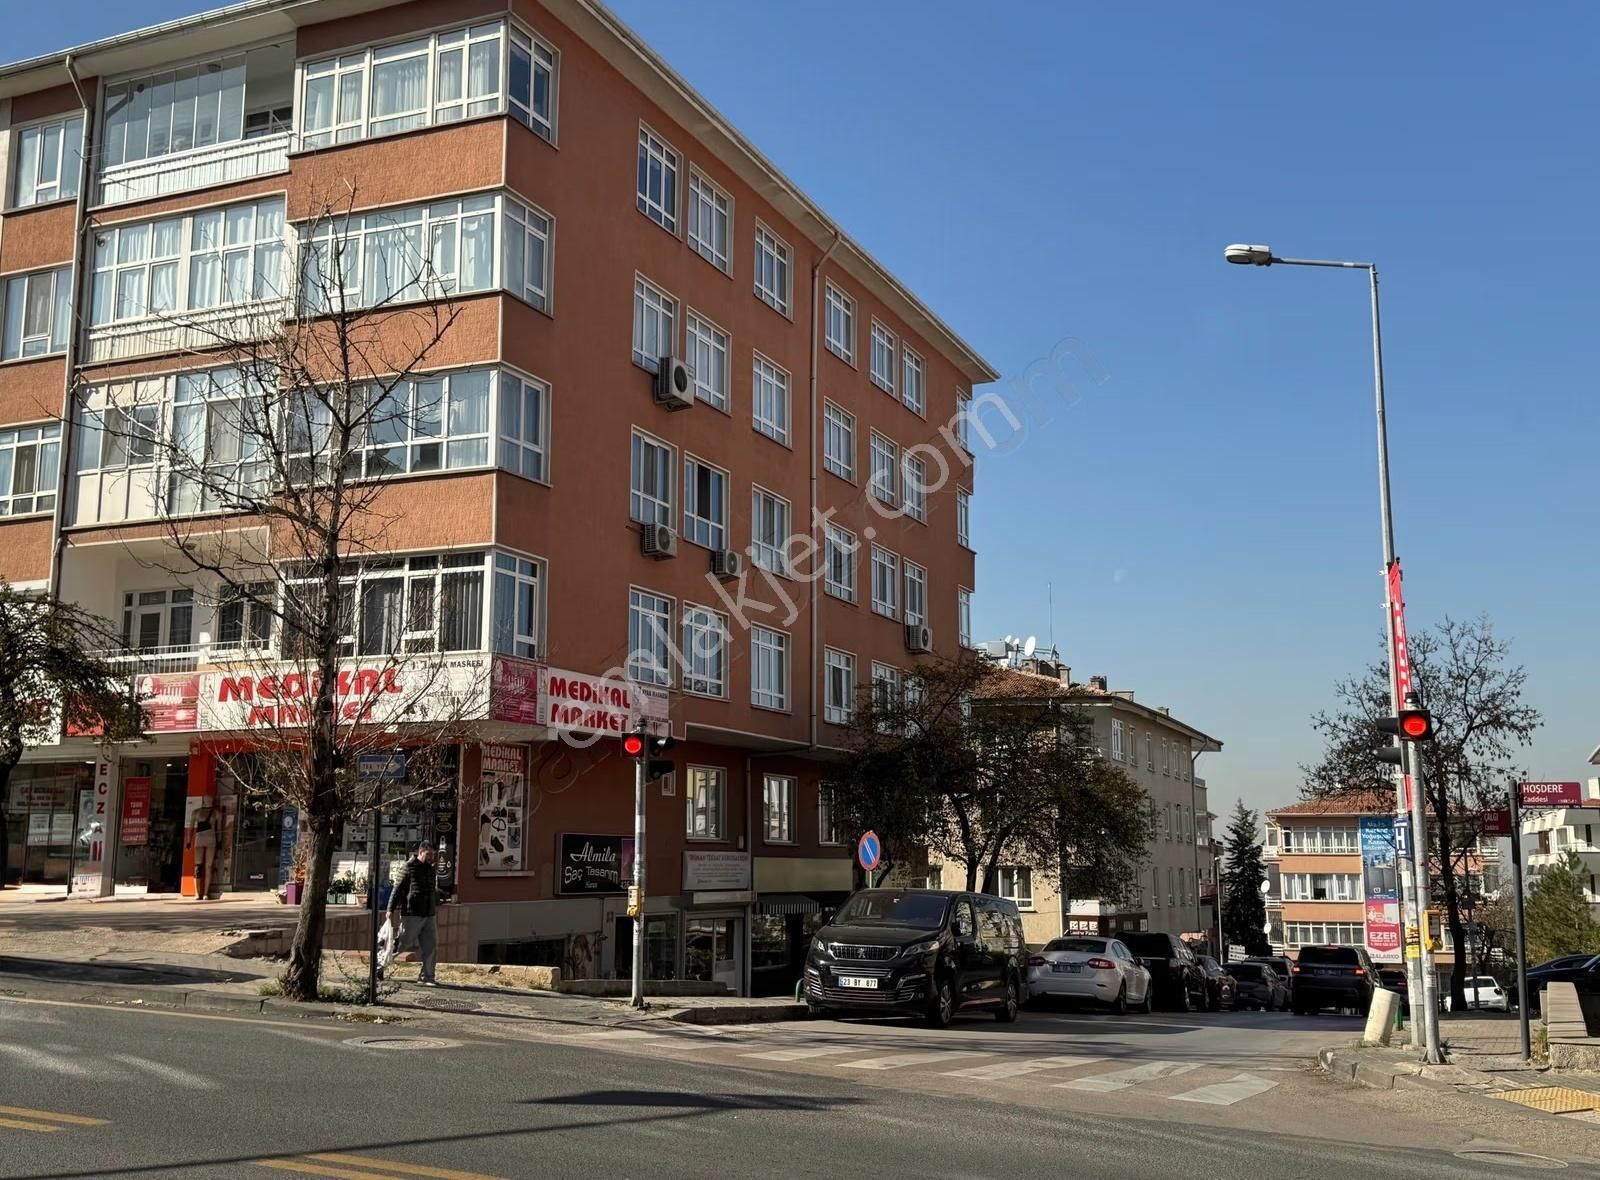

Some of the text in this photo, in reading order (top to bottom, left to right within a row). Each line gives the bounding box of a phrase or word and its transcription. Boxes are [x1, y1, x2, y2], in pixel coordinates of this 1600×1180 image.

[551, 703, 629, 732] MARKET
[1523, 784, 1563, 795] HOŞDERE
[569, 841, 616, 862] Almila
[564, 866, 618, 884] Saç Tasarım
[1370, 931, 1397, 940] EZER
